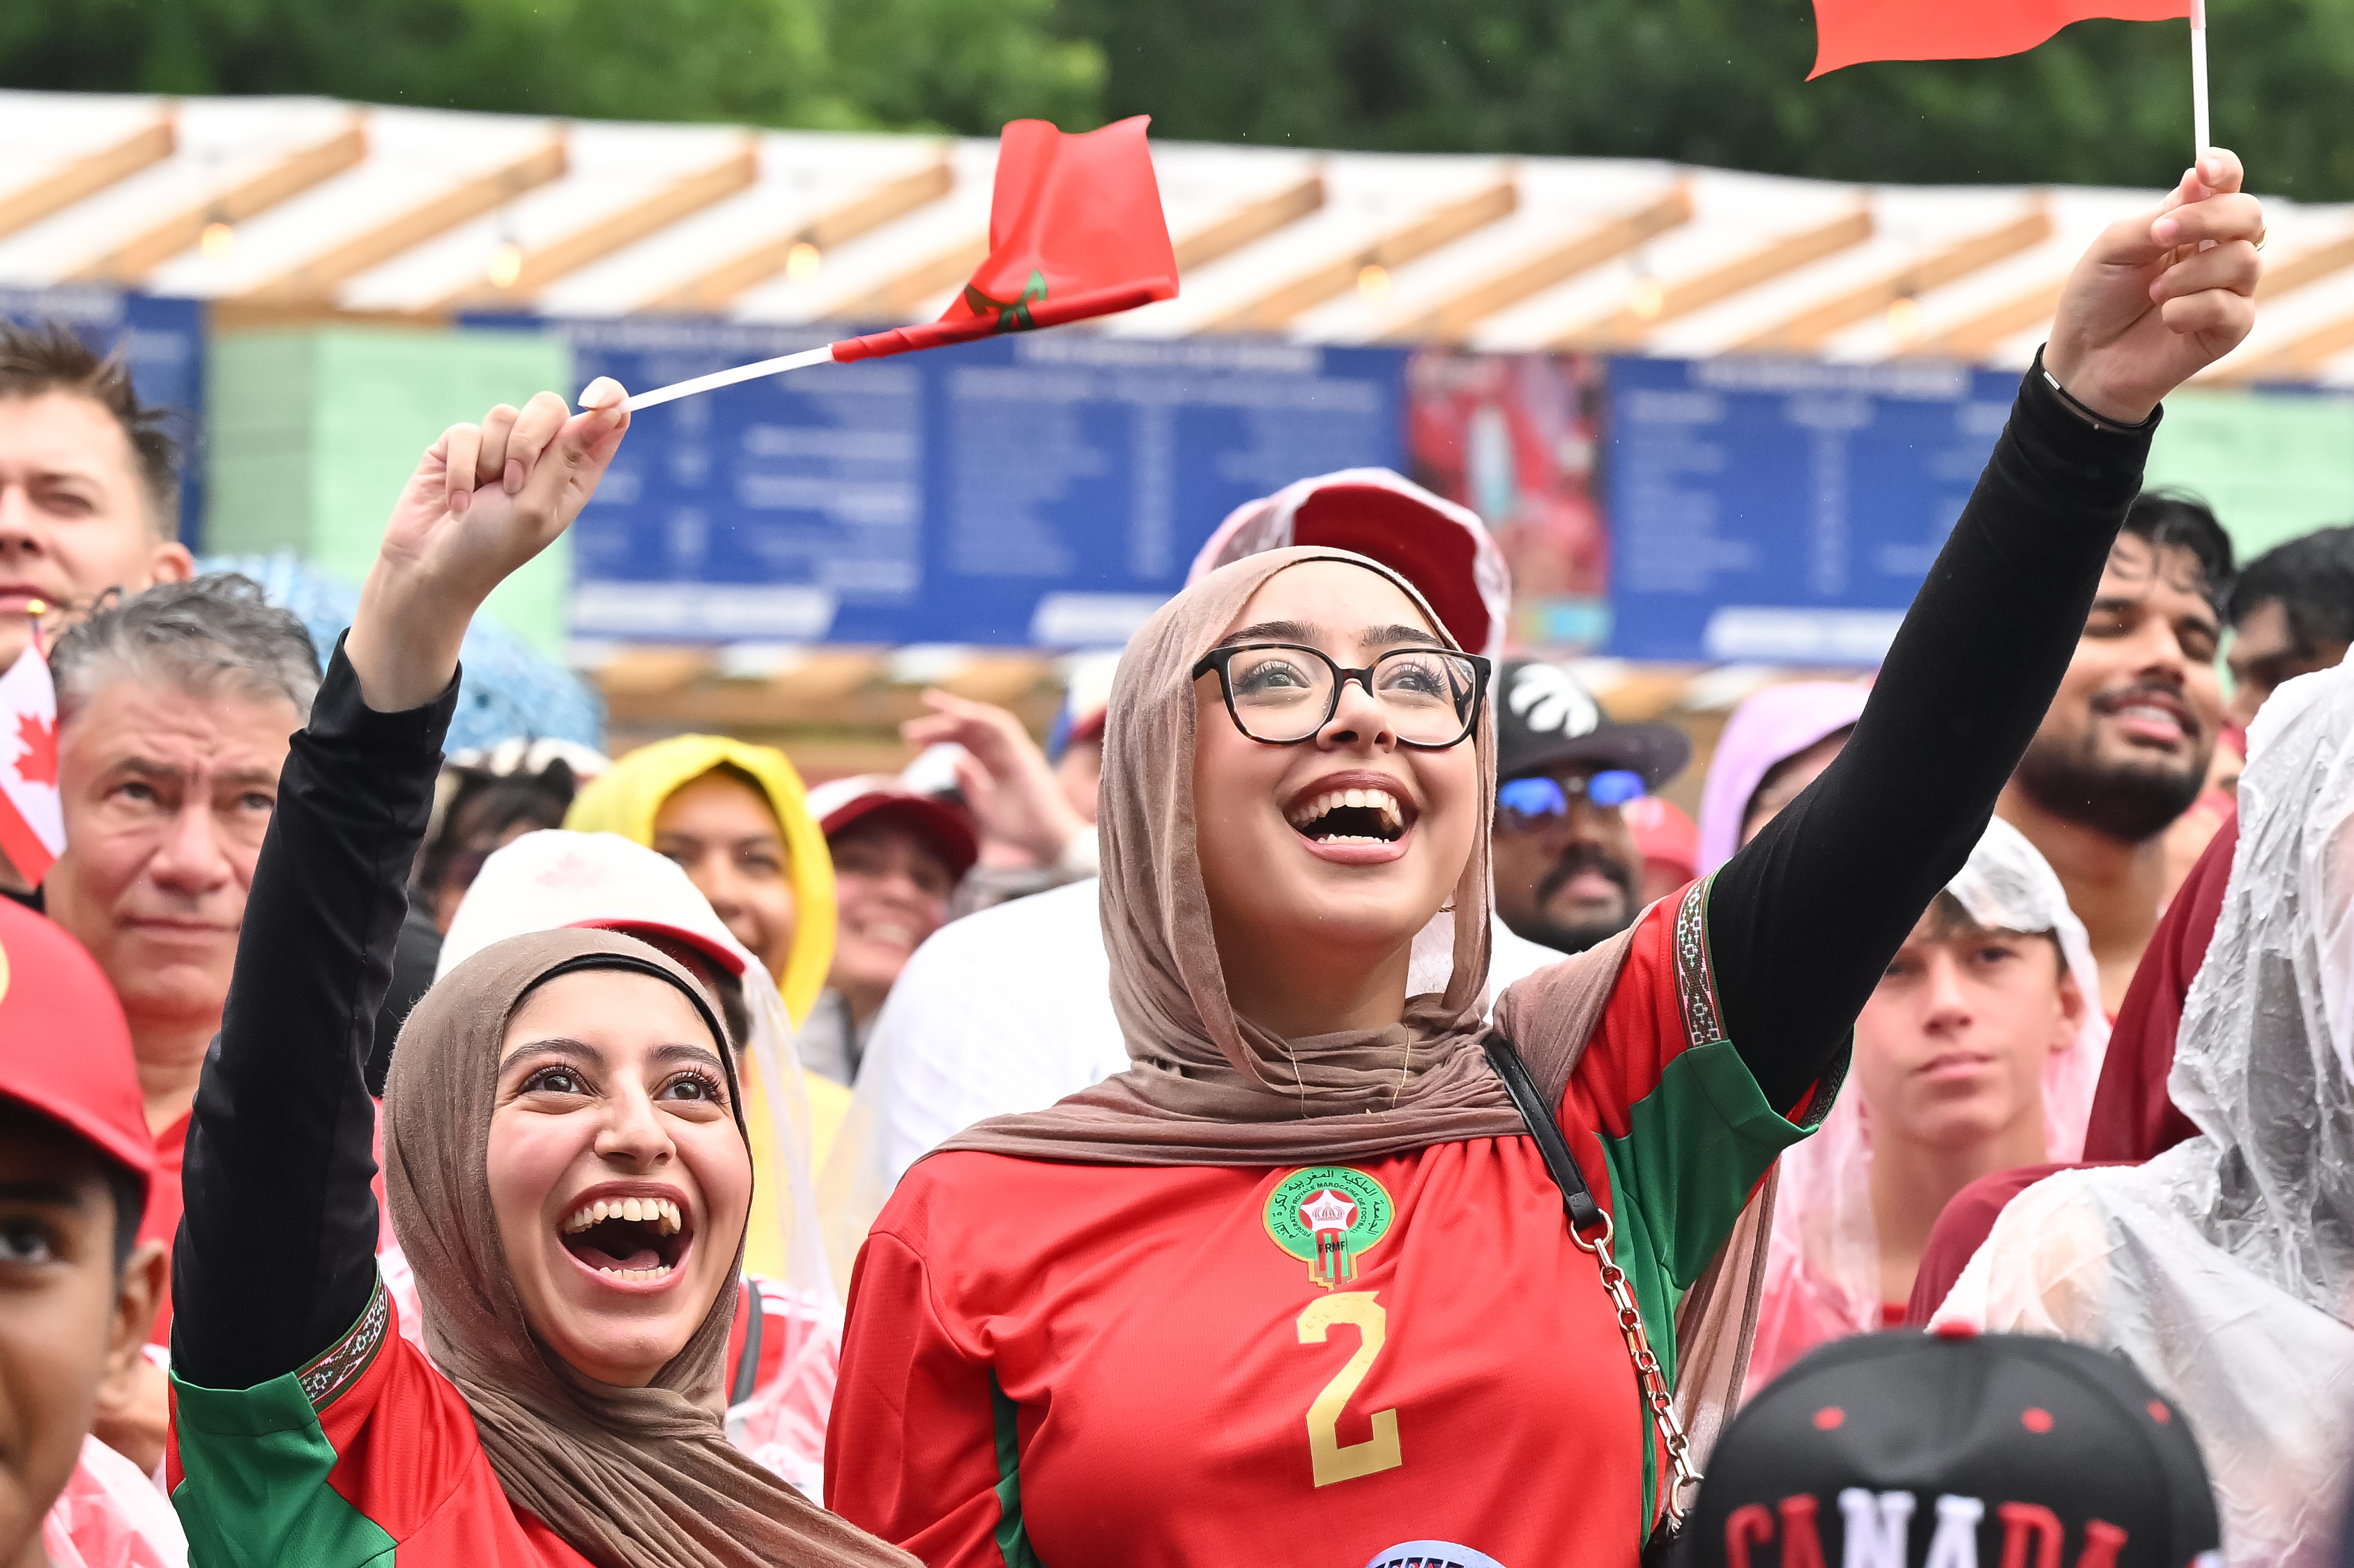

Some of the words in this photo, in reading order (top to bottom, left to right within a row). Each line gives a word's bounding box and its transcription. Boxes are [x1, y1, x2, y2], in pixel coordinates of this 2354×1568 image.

[1283, 1169, 1334, 1191] المغربية
[1317, 1182, 1360, 1198] MAROCAINE
[1341, 1171, 1378, 1197] الملكية
[1272, 1193, 1288, 1217] لكرة
[1292, 1185, 1316, 1204] ROYALE
[1356, 1197, 1366, 1206] DE
[1350, 1206, 1368, 1233] FOOTBALL
[1366, 1199, 1385, 1236] الجامعة
[1273, 1221, 1299, 1239] القدم
[1317, 1240, 1345, 1254] FRMF
[1297, 1292, 1402, 1488] 2
